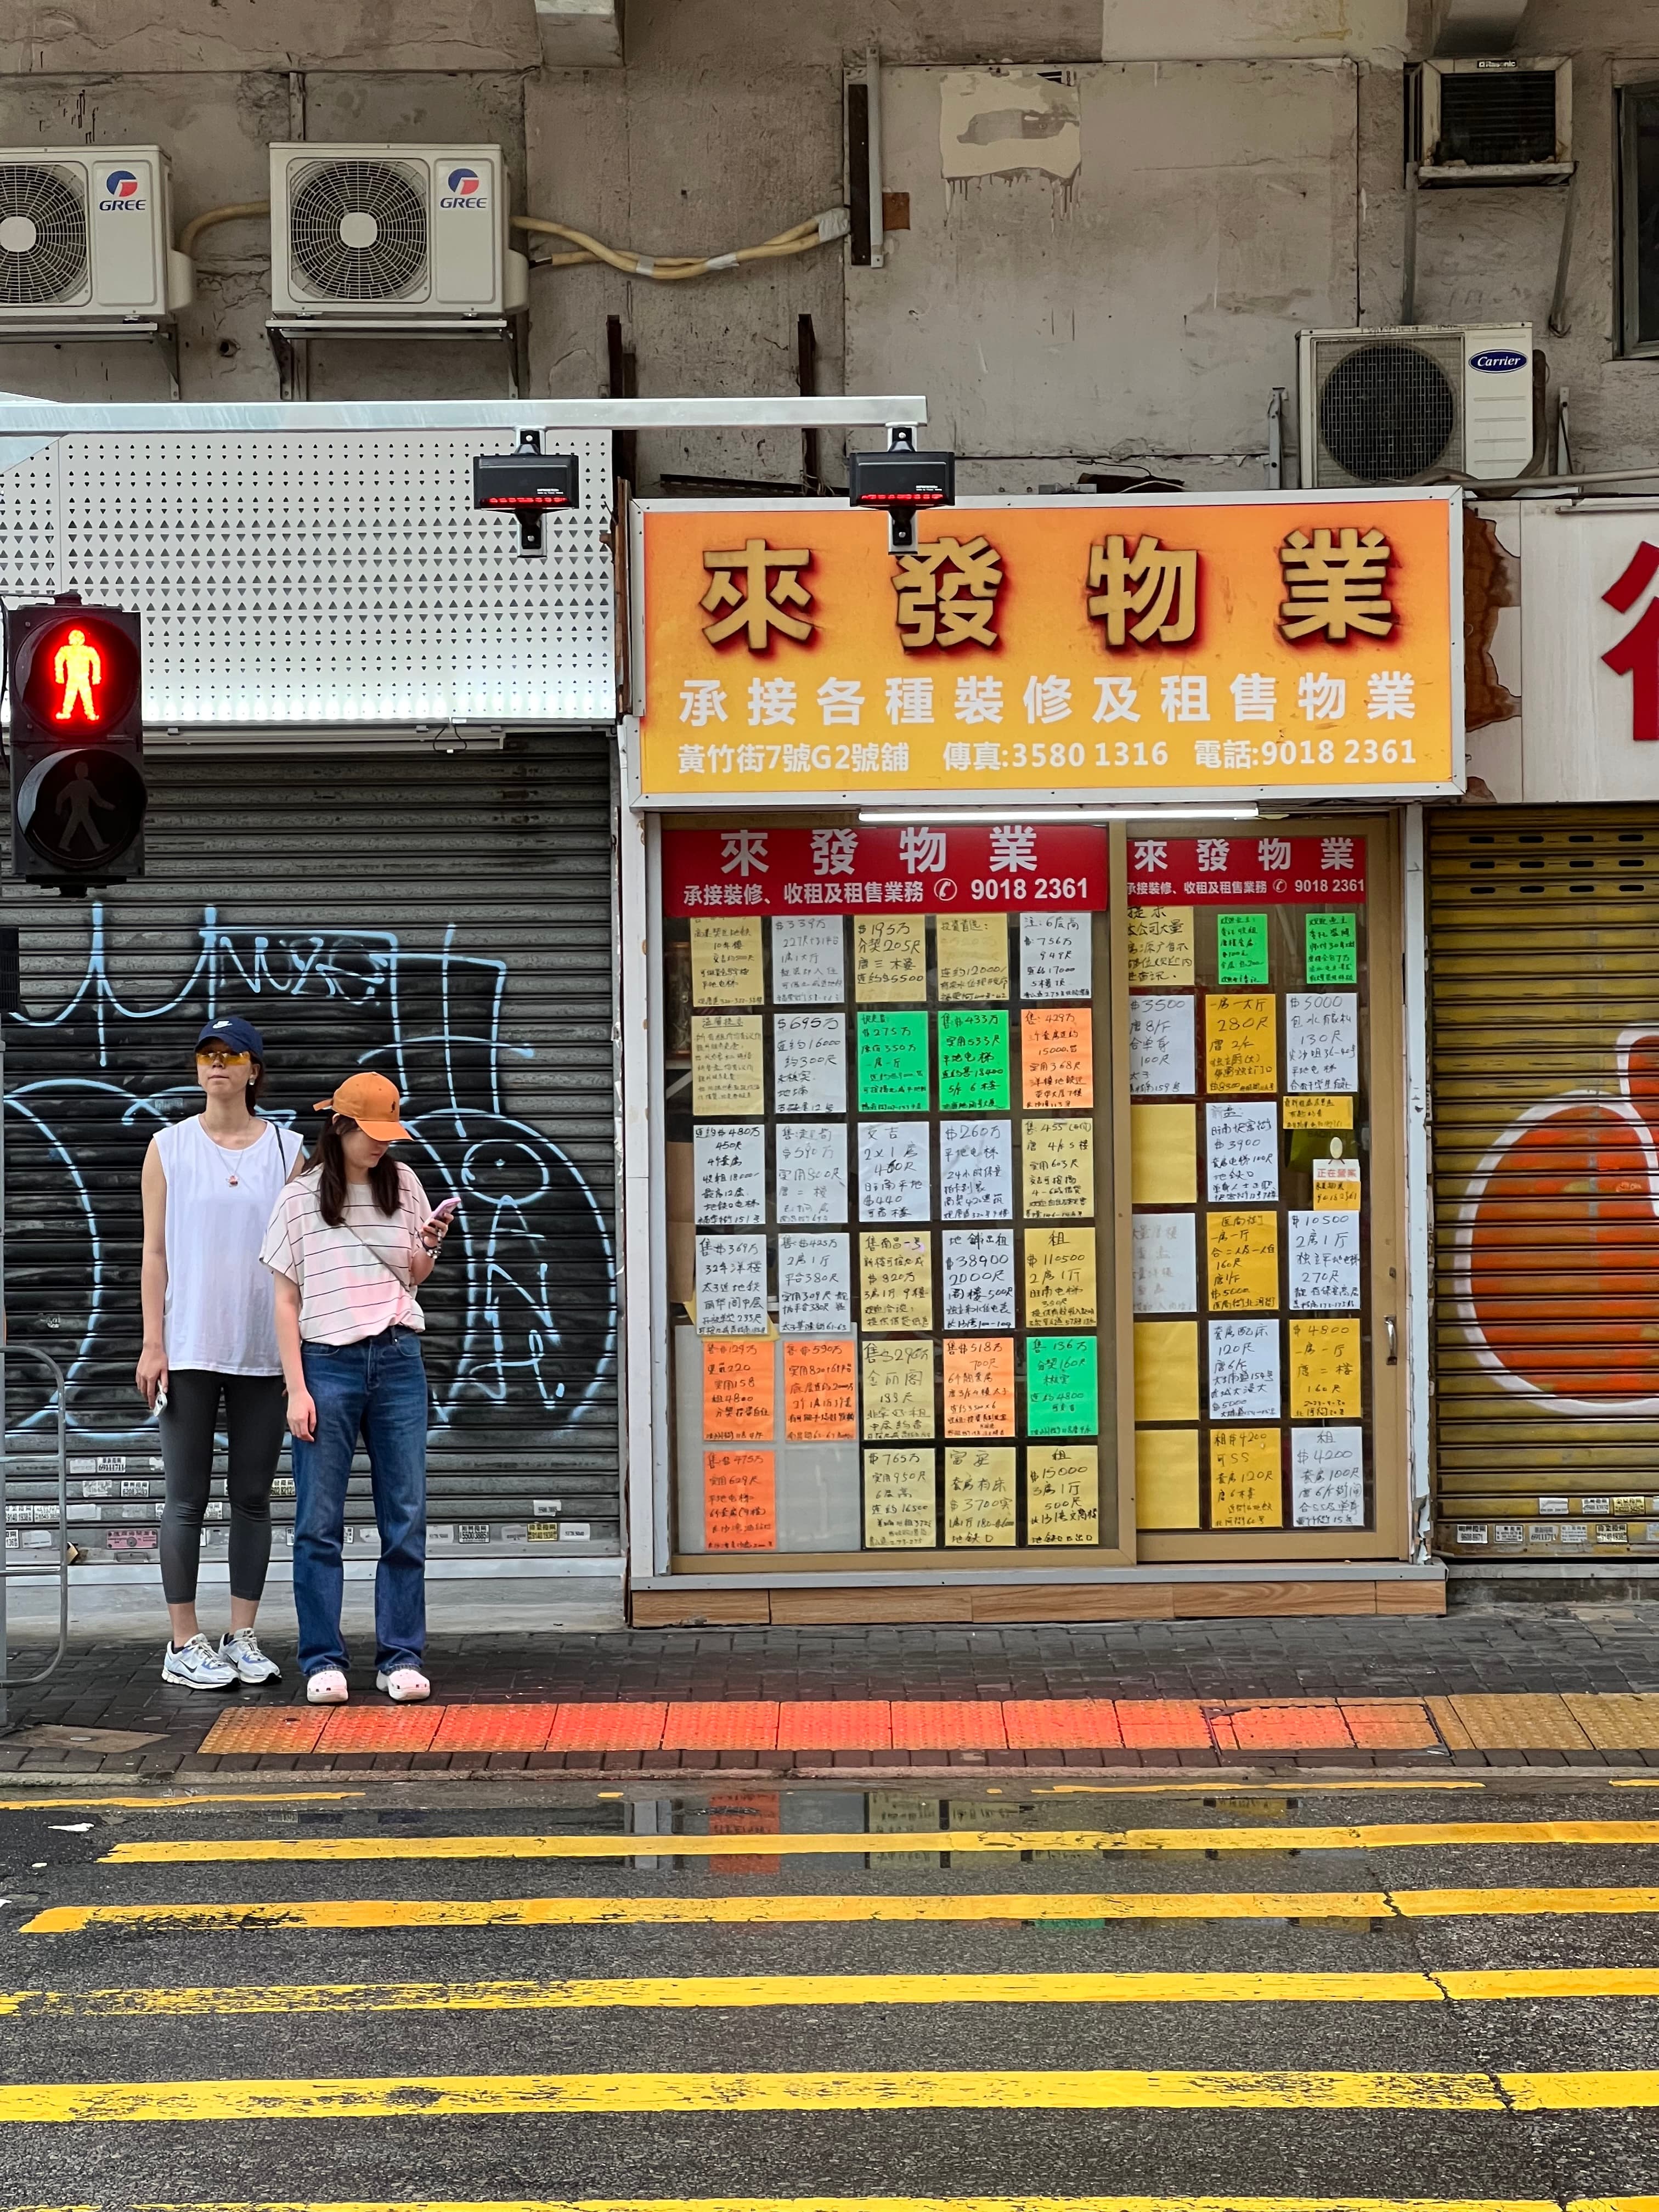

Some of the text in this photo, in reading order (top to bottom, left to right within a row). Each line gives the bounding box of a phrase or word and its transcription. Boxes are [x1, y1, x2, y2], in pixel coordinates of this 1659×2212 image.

[99, 198, 146, 211] GREE
[441, 196, 487, 210] GREE
[1477, 356, 1521, 367] Carrier
[698, 527, 1398, 651] 來發物業
[679, 671, 1415, 726] 承接各種裝修及租售物業
[943, 741, 1085, 770] 傳真:3580
[1095, 741, 1168, 766] 1316
[1194, 739, 1334, 769] 電話:9018
[1344, 739, 1416, 763] 2361
[721, 827, 1037, 877] 來發物業
[1134, 837, 1354, 872] 來發物業
[684, 877, 1088, 906] 承接裝修、收租及租售業務 9018 2361
[1295, 879, 1328, 893] 9018
[1332, 879, 1364, 892] 2361
[776, 918, 826, 930] $339万
[857, 922, 910, 938] $195万
[1130, 1000, 1186, 1013] $3500
[1290, 996, 1342, 1011] $5000
[777, 1017, 839, 1030] $695万
[1217, 1017, 1269, 1032] 280尺
[1300, 1030, 1342, 1045] 130尺
[945, 1125, 1001, 1141] $260万
[1214, 1139, 1261, 1151] $3900
[1292, 1215, 1349, 1229] $10500
[1295, 1229, 1349, 1248] 2房1厅
[946, 1254, 1008, 1271] $38900
[1217, 1257, 1243, 1271] 160尺
[949, 1270, 1006, 1286] 2000尺
[1302, 1270, 1340, 1284] 270尺
[1293, 1325, 1350, 1339] $4800
[1218, 1342, 1255, 1356] 120尺
[868, 1453, 920, 1465] $765万
[1297, 1449, 1353, 1464] $4200
[1030, 1466, 1088, 1483] $15000
[1032, 1481, 1082, 1497] 3房1厅
[1045, 1496, 1082, 1511] 500尺
